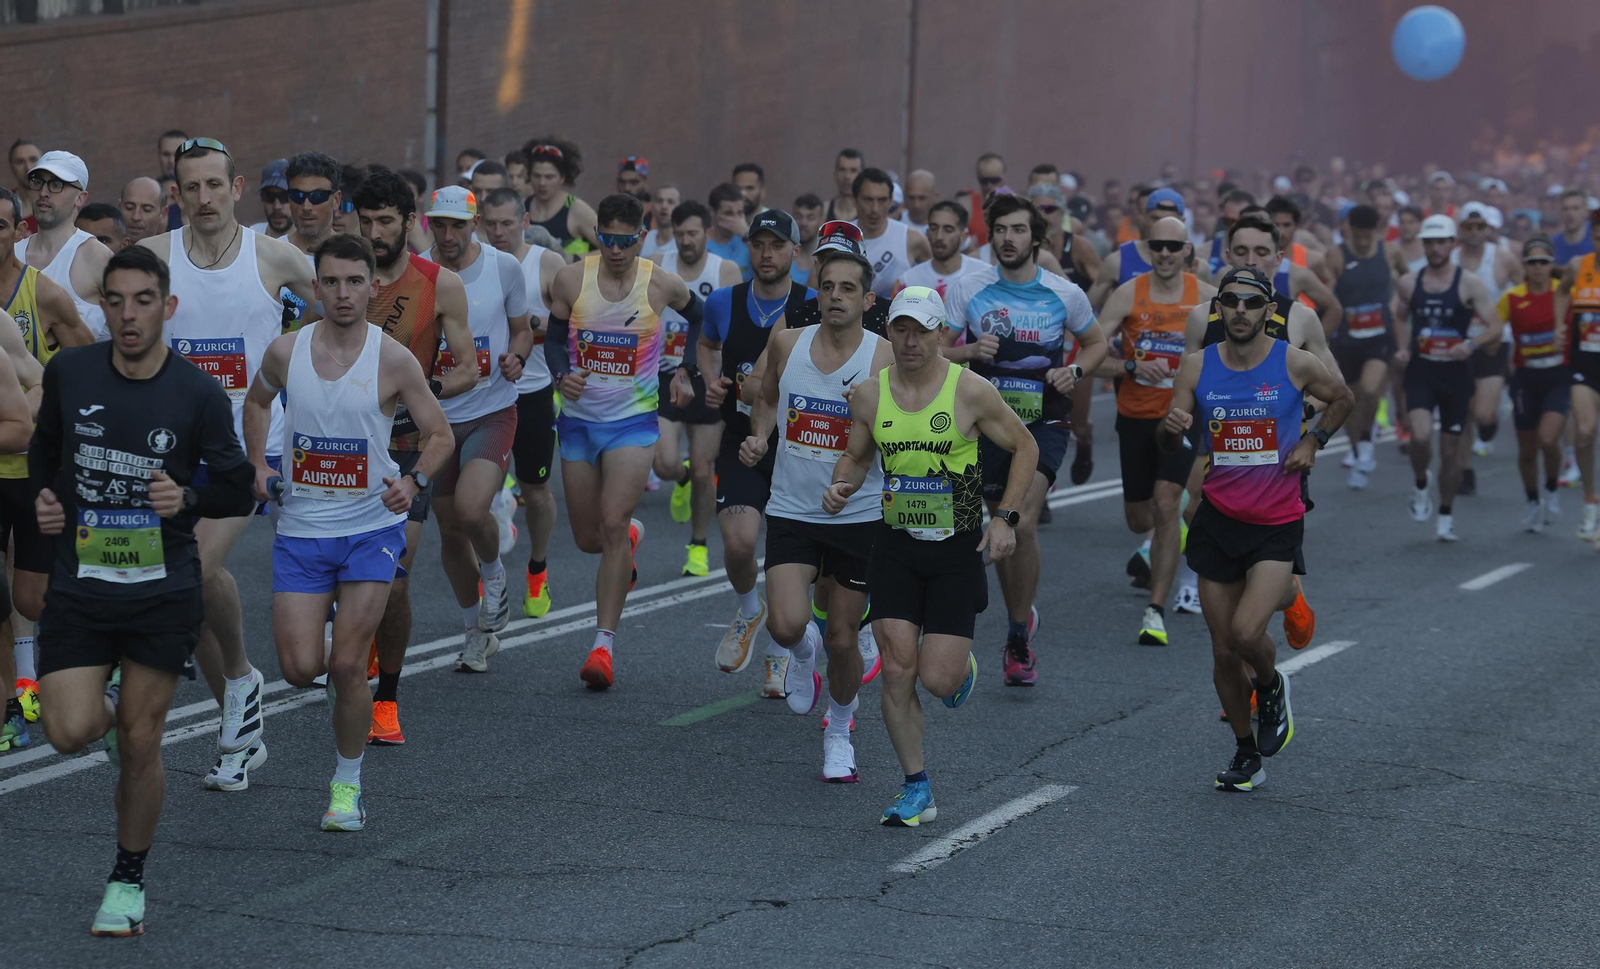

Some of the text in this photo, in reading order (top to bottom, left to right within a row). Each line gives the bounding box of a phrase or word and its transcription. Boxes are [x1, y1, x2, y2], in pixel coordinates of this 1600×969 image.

[1015, 313, 1051, 330] PATOU
[597, 335, 631, 345] ZURICH
[1014, 329, 1041, 342] TRAIL
[195, 342, 236, 352] ZURICH
[597, 350, 615, 360] 1203
[198, 361, 220, 371] 1170
[581, 356, 630, 375] LORENZO
[1003, 381, 1036, 390] ZURICH
[810, 401, 848, 414] ZURICH
[1229, 407, 1267, 417] ZURICH
[809, 419, 830, 430] 1086
[1232, 426, 1252, 435] 1060
[797, 430, 840, 448] JONNY
[1223, 437, 1264, 451] PEDRO
[316, 441, 358, 451] ZURICH
[79, 443, 163, 469] CLUB ATLETISMO
[74, 453, 166, 479] PUERTO TORREVI
[320, 460, 337, 469] 897
[301, 469, 357, 486] AURYAN
[105, 479, 127, 494] AS
[904, 481, 943, 491] ZURICH
[906, 500, 927, 509] 1479
[102, 514, 149, 525] ZURICH
[898, 512, 937, 526] DAVID
[104, 537, 130, 547] 2406
[99, 551, 140, 565] JUAN
